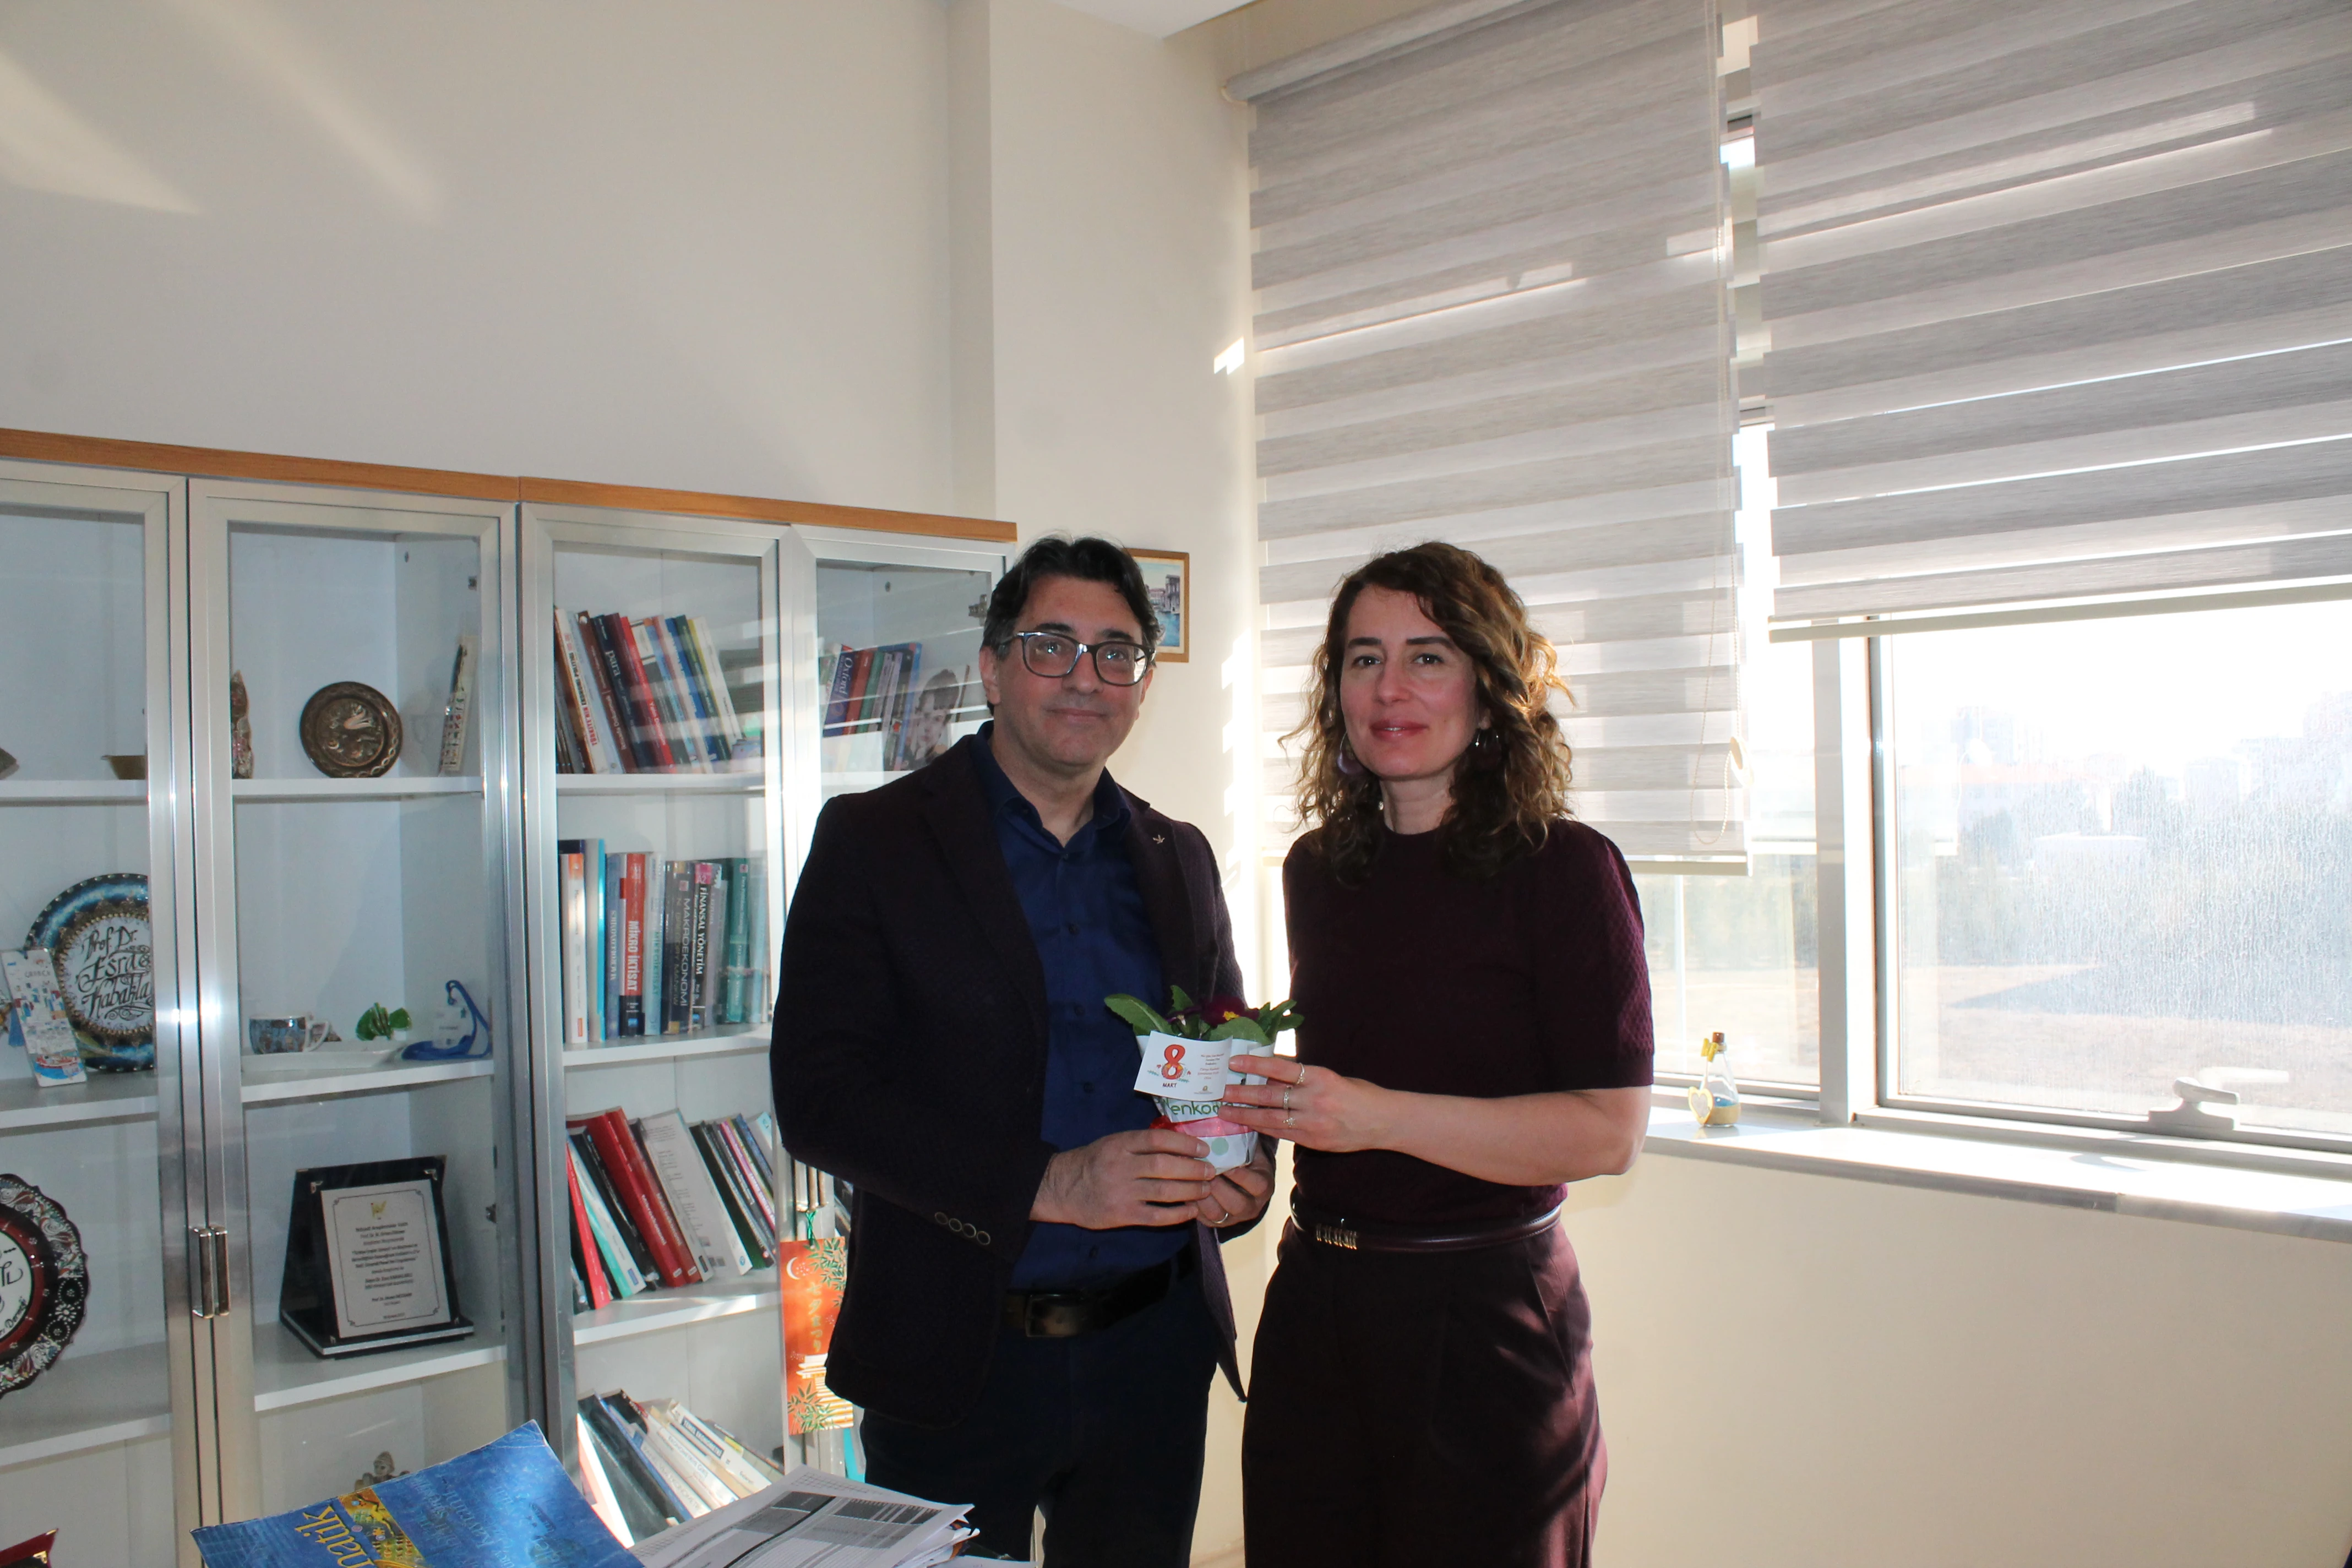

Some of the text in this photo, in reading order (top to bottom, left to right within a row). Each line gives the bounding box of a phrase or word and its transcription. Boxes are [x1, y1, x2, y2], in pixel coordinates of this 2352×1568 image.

[605, 649, 622, 676] para
[838, 657, 853, 695] Oxford
[81, 926, 138, 962] Prof. Dr.
[628, 921, 639, 952] MİKRO
[696, 887, 707, 974] FİNANSAL YÖNETİM
[628, 955, 639, 991] İKTİSAT
[1162, 1044, 1185, 1080] 8
[806, 1282, 823, 1352] 七夕まつり
